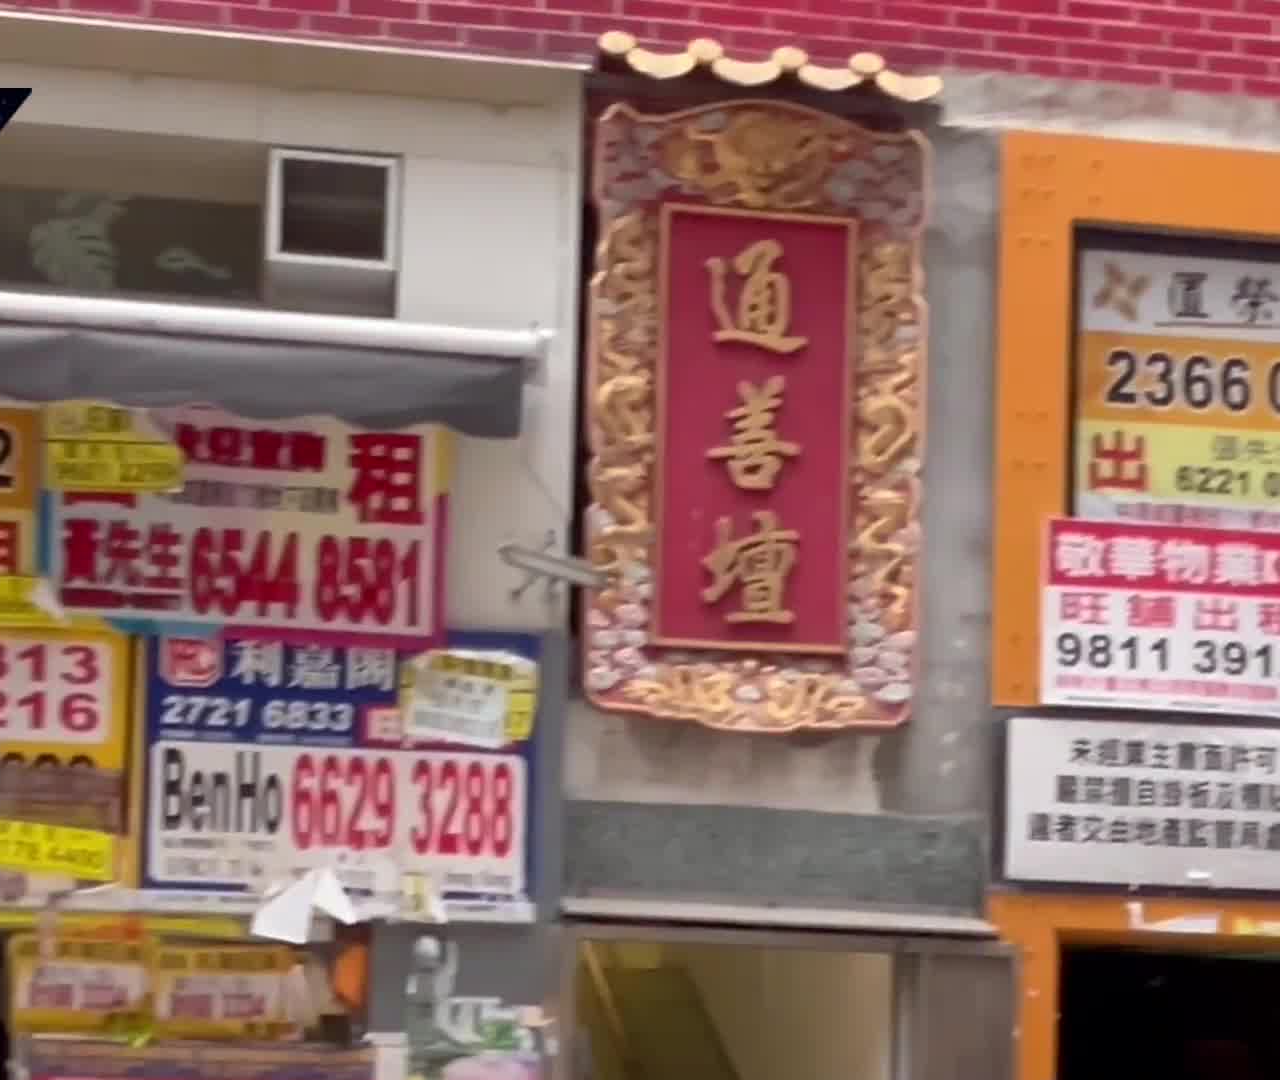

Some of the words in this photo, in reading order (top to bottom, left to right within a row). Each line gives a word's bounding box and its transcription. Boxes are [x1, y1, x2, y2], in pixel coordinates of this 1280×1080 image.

[1105, 349, 1251, 413] 2366
[700, 238, 809, 626] 通善壇
[1088, 431, 1149, 492] 出
[1057, 633, 1170, 671] 9811
[160, 695, 252, 728] 2721
[261, 700, 355, 732] 6833
[291, 752, 396, 851] 6629
[410, 758, 513, 859] 3288
